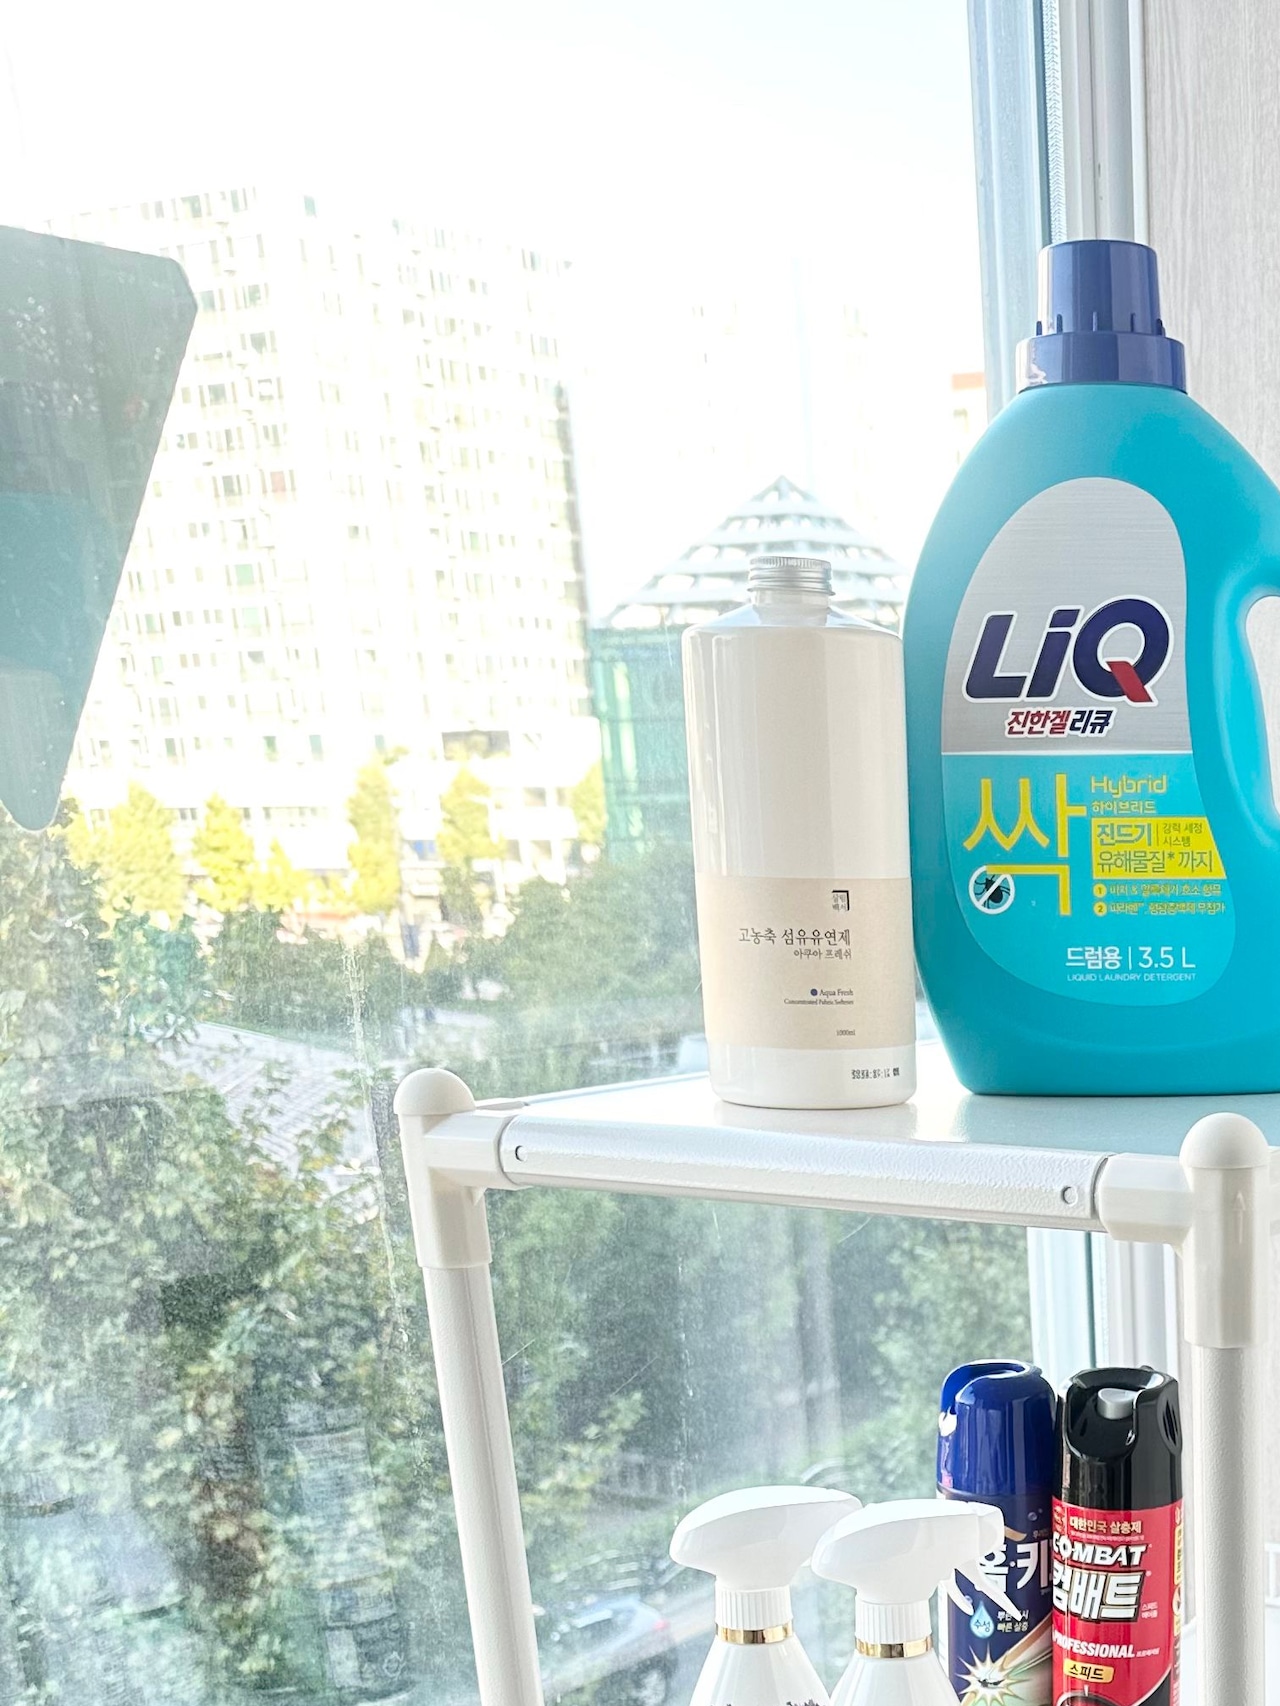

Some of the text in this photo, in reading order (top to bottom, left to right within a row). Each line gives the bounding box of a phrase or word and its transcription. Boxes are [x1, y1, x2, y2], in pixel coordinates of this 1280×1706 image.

[963, 596, 1172, 704] LiQ
[1091, 774, 1167, 798] Hybrid
[1092, 800, 1157, 814] 하이브리드
[963, 774, 1087, 916] 싹
[1097, 823, 1152, 846] 진드기
[1178, 850, 1213, 873] 까지
[739, 927, 851, 946] 고농축 섬유유연제
[794, 948, 822, 960] 아쿠아
[1066, 946, 1196, 970] 드럼용 3.5 L
[1067, 973, 1196, 982] LIQUID LAUNDRY DETERGENT
[820, 988, 854, 998] Aqua Fresh
[1069, 1517, 1142, 1534] 대한민국 살충제
[1053, 1531, 1147, 1567] COMBAT
[975, 1619, 991, 1632] 수성
[1053, 1629, 1135, 1658] PROFESSIONAL
[1069, 1664, 1104, 1680] 스피드
